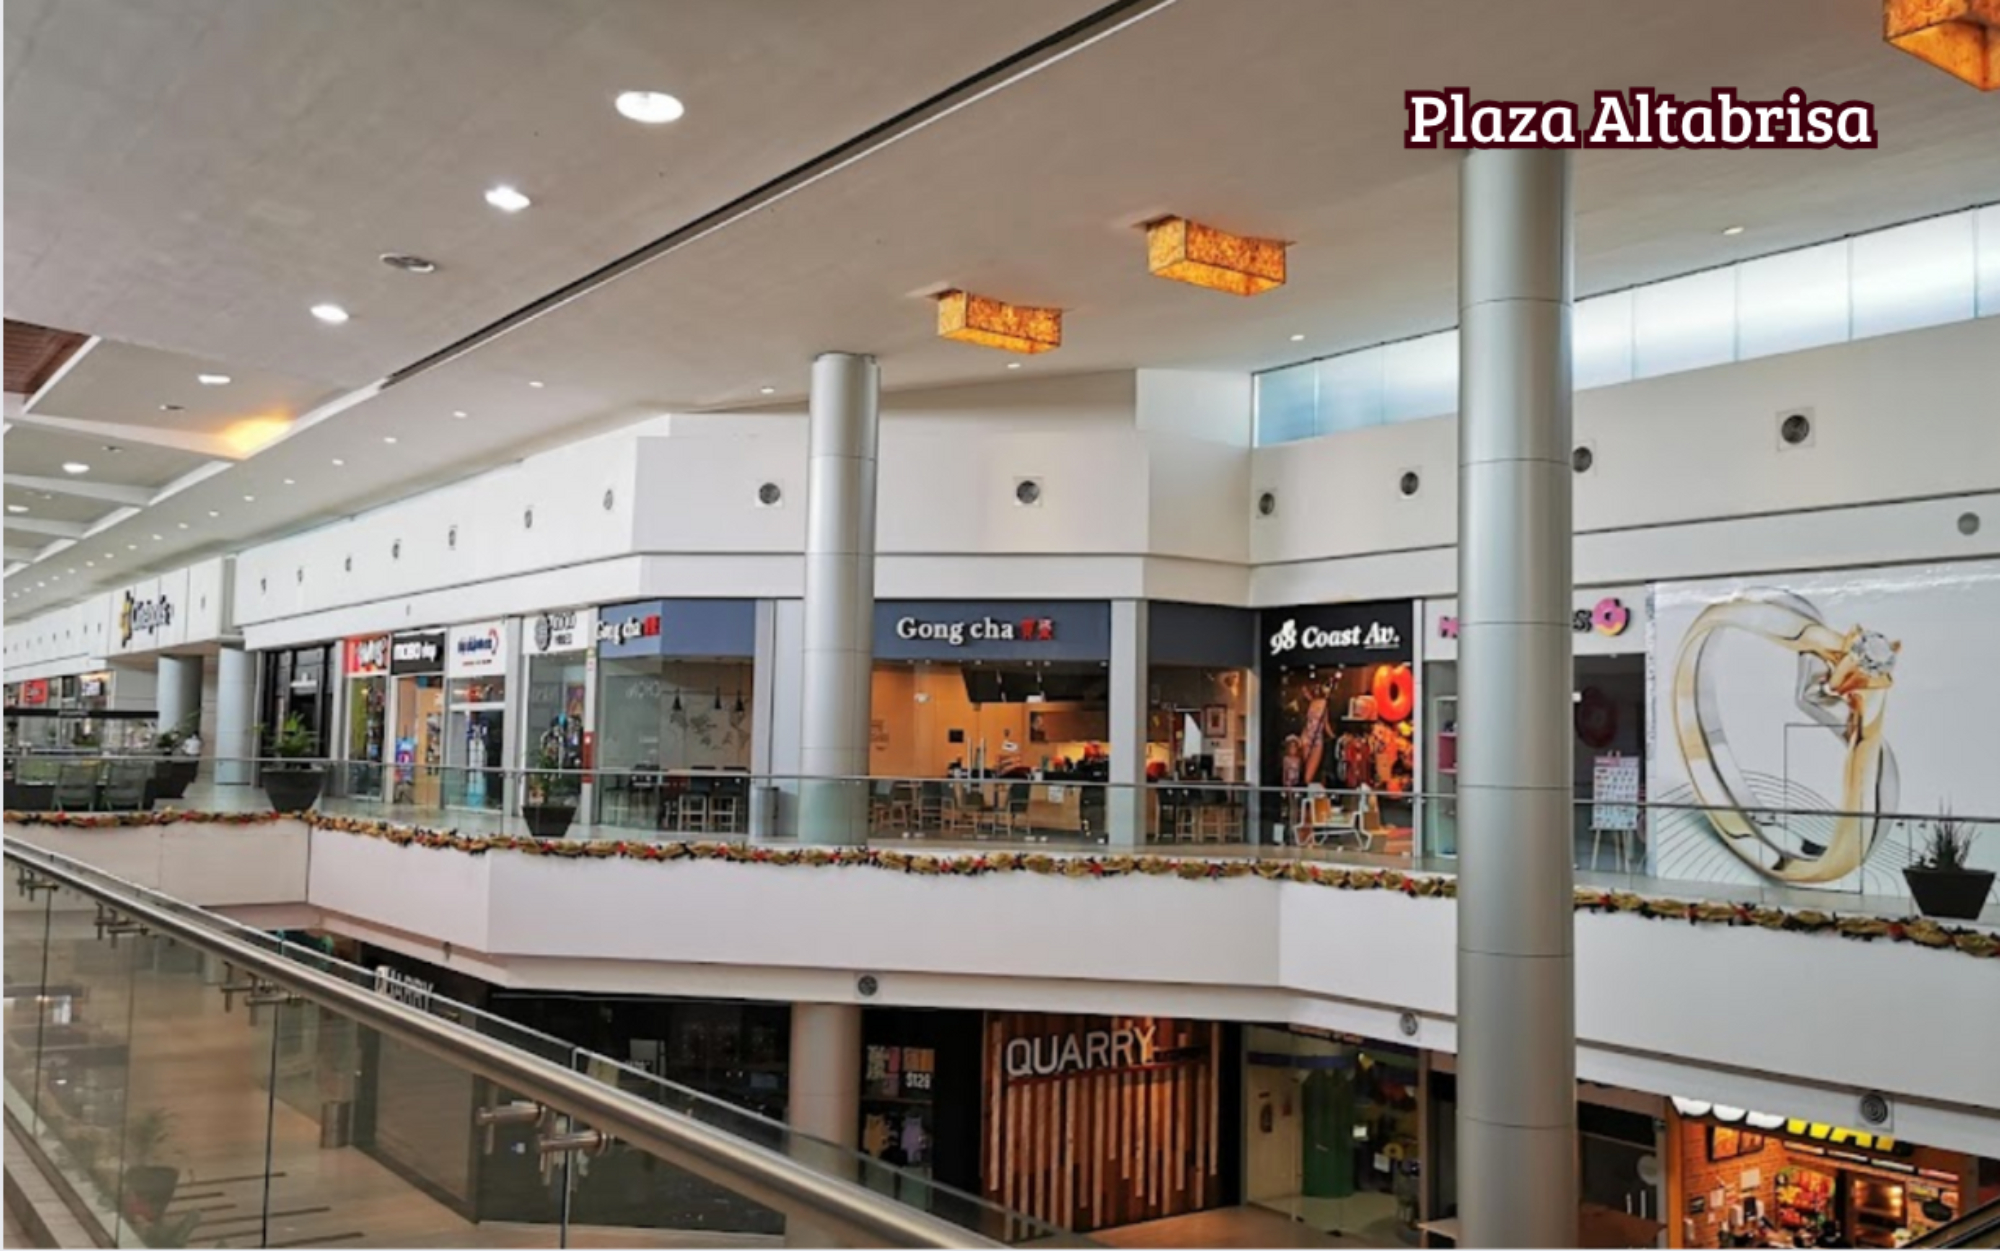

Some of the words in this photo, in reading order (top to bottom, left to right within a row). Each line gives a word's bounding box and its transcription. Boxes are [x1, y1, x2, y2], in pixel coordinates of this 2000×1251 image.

[896, 616, 965, 646] Gong
[969, 616, 1014, 640] cha
[1270, 618, 1298, 655] 98
[1301, 624, 1362, 649] Coast
[1363, 621, 1401, 649] Av.
[1006, 1025, 1157, 1077] QUARRY
